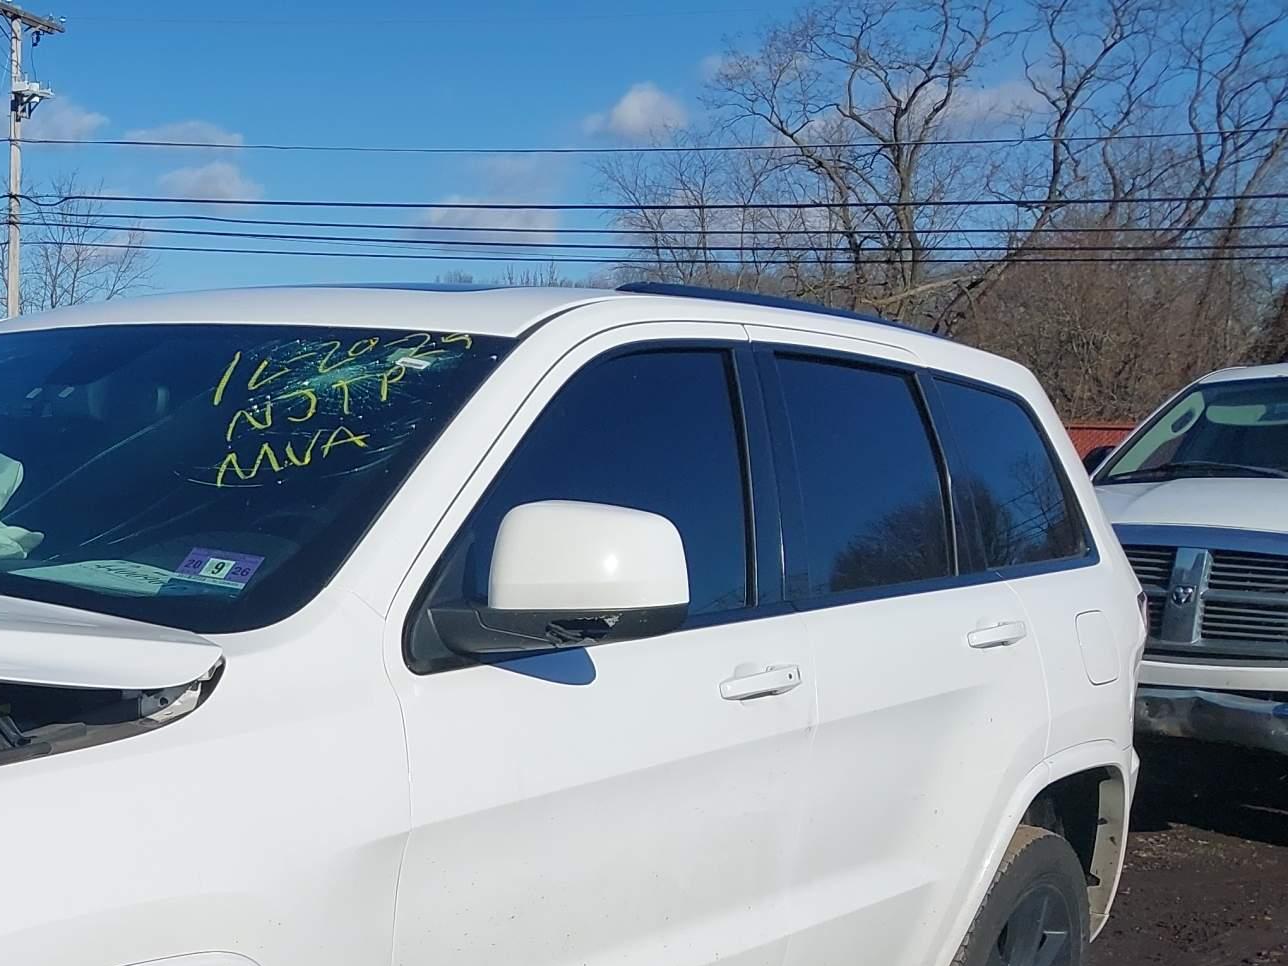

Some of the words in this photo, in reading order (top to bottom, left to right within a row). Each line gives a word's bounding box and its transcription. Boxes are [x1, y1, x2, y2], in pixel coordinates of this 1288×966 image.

[216, 426, 370, 489] MVA
[184, 559, 202, 569] 20
[211, 562, 226, 575] 9
[231, 566, 251, 577] 26
